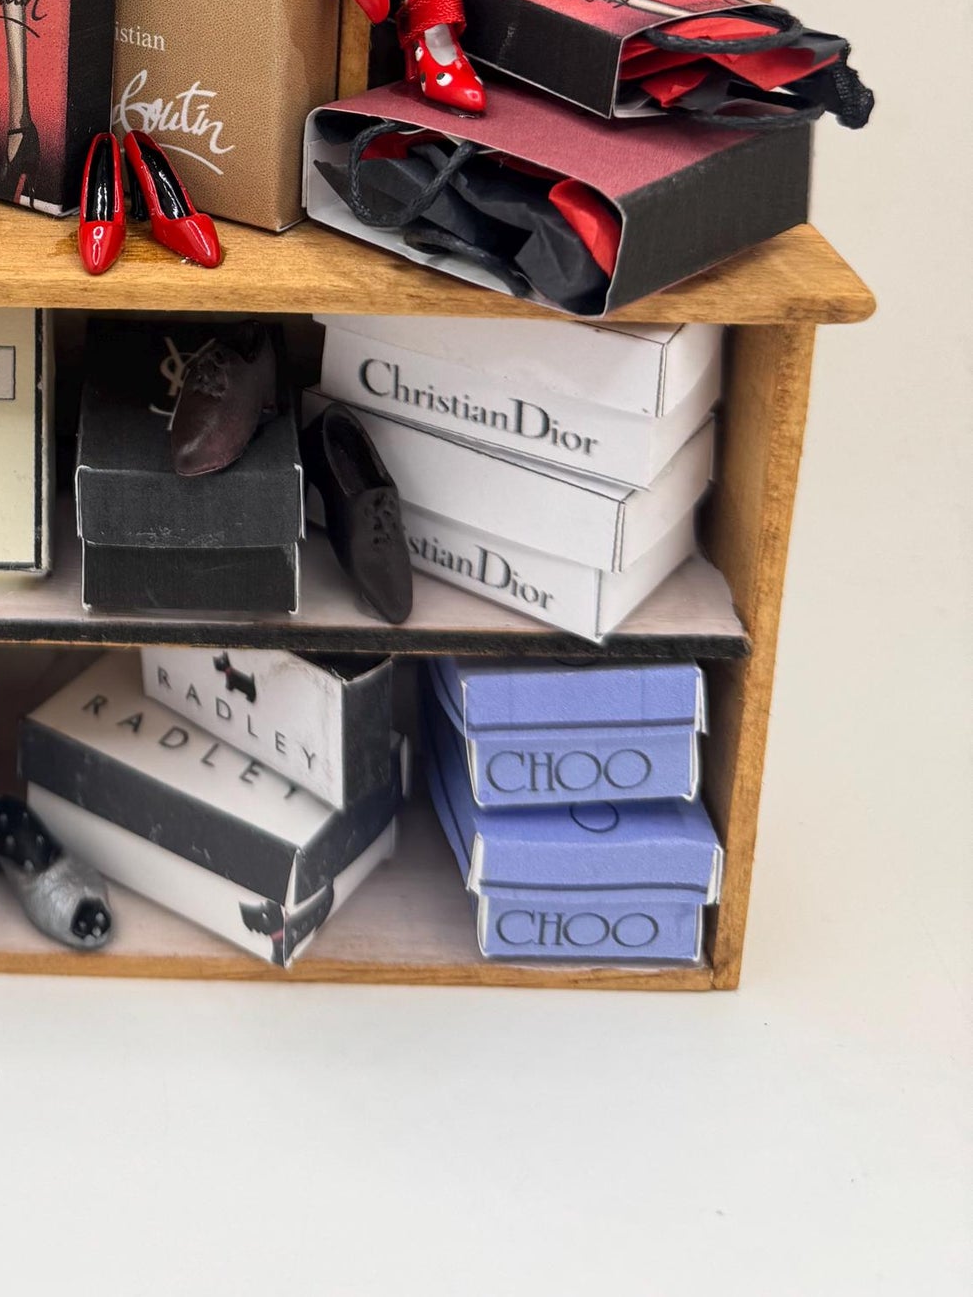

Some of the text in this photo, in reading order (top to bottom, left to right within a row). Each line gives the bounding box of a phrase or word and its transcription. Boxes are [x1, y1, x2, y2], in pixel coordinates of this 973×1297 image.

[157, 665, 317, 770] RADLEY
[486, 748, 652, 794] CHOO
[496, 908, 659, 948] CHOO
